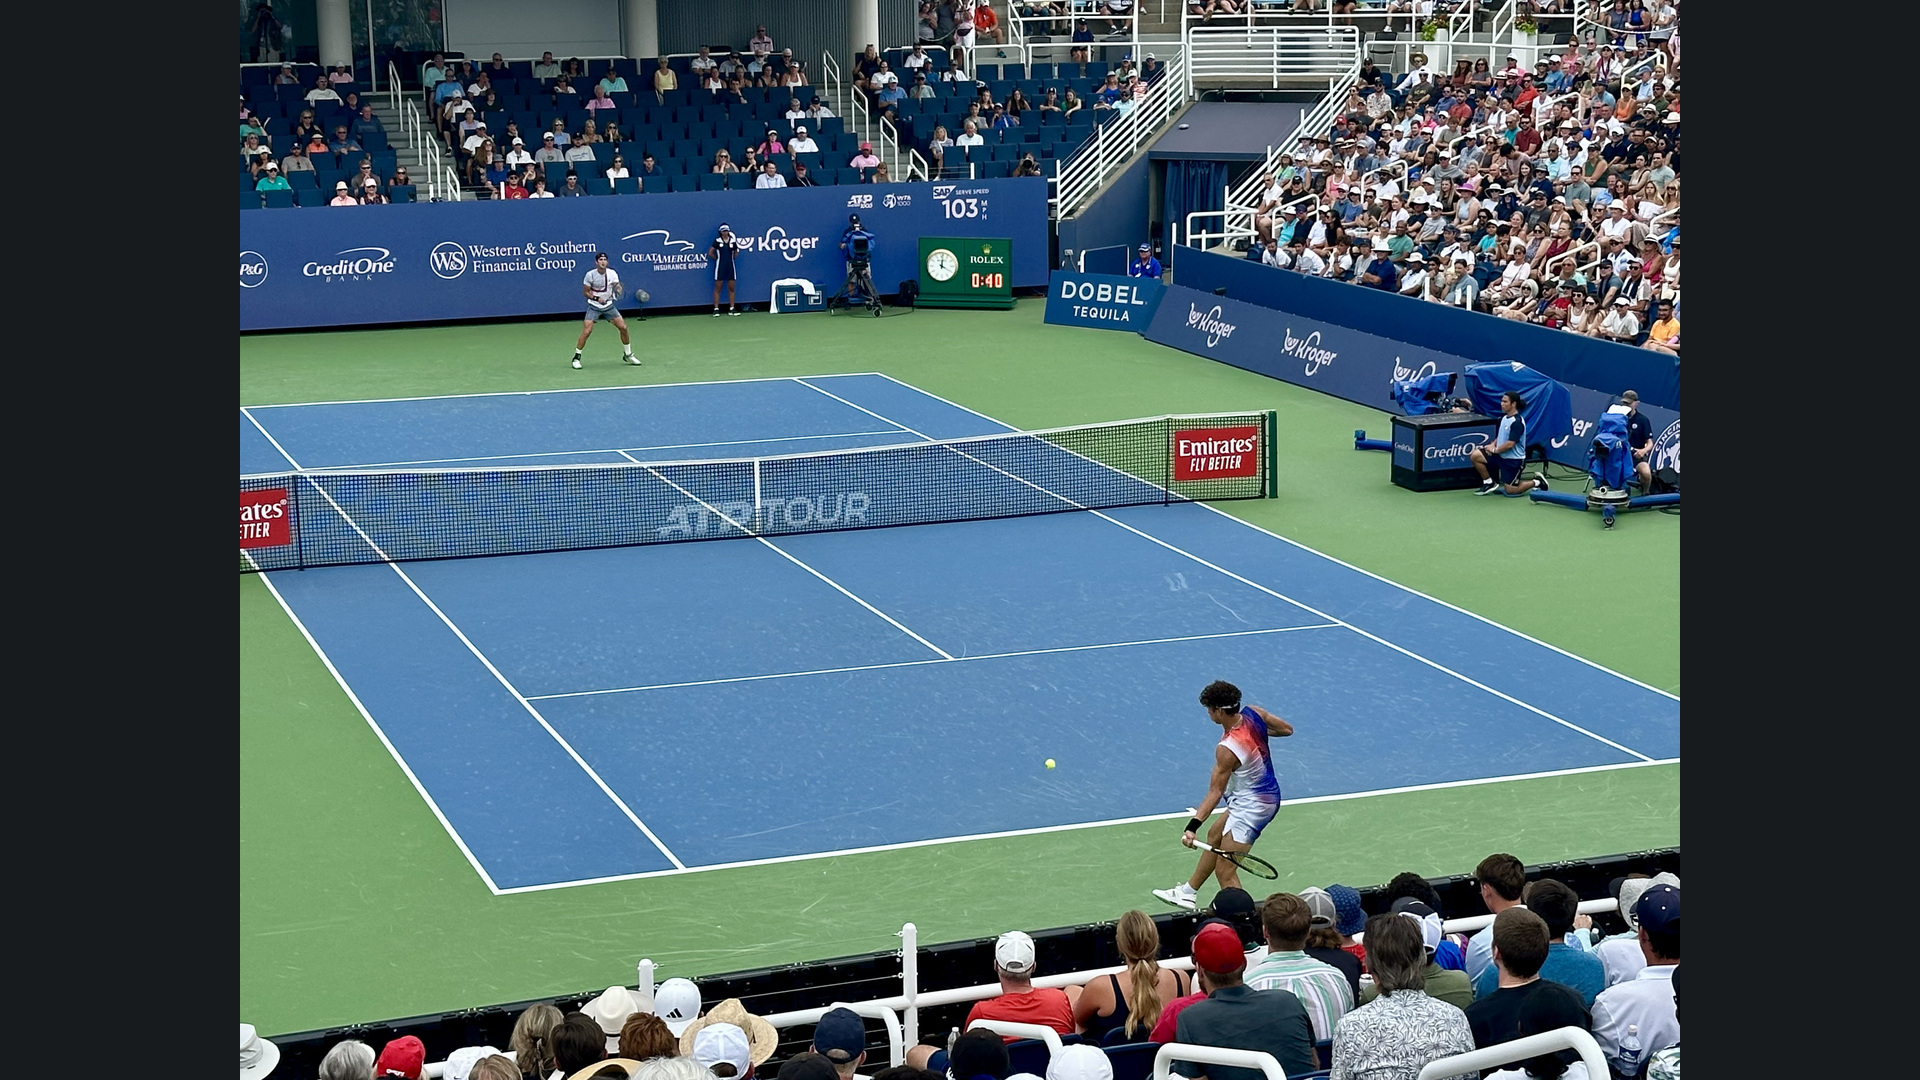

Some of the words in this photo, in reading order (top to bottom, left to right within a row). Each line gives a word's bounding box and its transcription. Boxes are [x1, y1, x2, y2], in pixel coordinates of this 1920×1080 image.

[942, 198, 978, 219] 103
[469, 245, 521, 258] Western
[524, 242, 537, 255] &
[540, 240, 597, 255] Southern
[758, 226, 819, 261] Kroger
[303, 258, 394, 277] CreditOne
[472, 258, 532, 273] Financial
[535, 257, 576, 272] Group
[688, 262, 708, 270] GROUP
[970, 256, 1004, 264] ROLEX
[240, 263, 264, 276] P&G
[326, 275, 373, 283] BANK
[971, 273, 1003, 288] 0:40
[1061, 281, 1144, 305] DOBEL
[1073, 306, 1130, 321] TEQUILA
[1198, 305, 1236, 348] Kroger
[1294, 331, 1338, 376] Kroger
[1179, 437, 1253, 457] Emirates
[1424, 442, 1485, 459] CreditO
[1189, 457, 1207, 472] FLY
[1207, 455, 1242, 471] BETTER
[761, 492, 871, 531] TOUR
